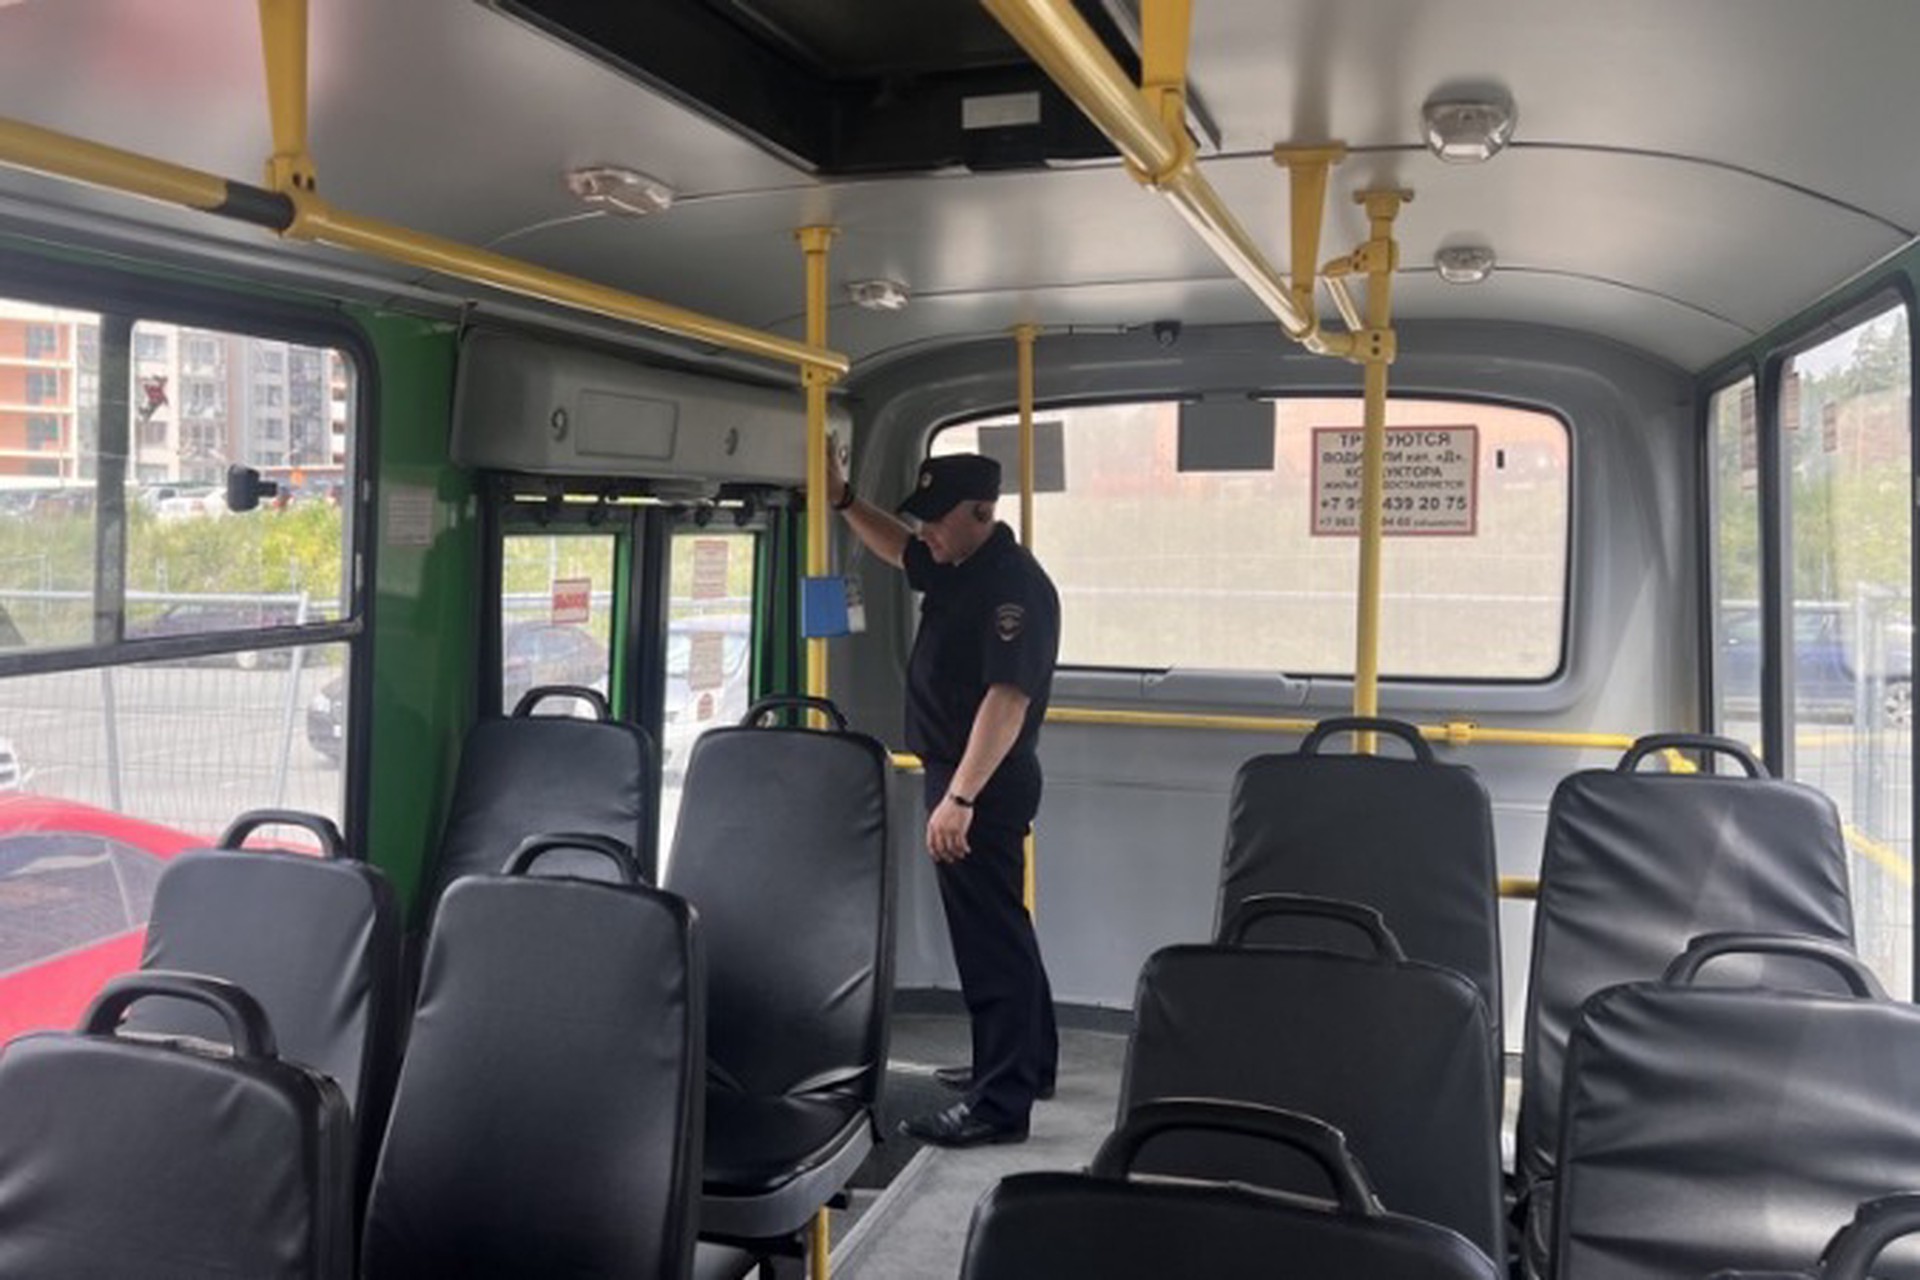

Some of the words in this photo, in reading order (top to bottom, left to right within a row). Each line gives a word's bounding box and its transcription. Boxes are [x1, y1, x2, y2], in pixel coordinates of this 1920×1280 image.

[1339, 432, 1451, 447] ТРУЮТСЯ
[1322, 451, 1402, 463] ВОДИЛИ
[1345, 466, 1442, 478] КОУКТОРА
[1321, 497, 1341, 510] +7
[1382, 497, 1414, 510] 439
[1418, 497, 1439, 510] 20
[1446, 497, 1467, 510] 75
